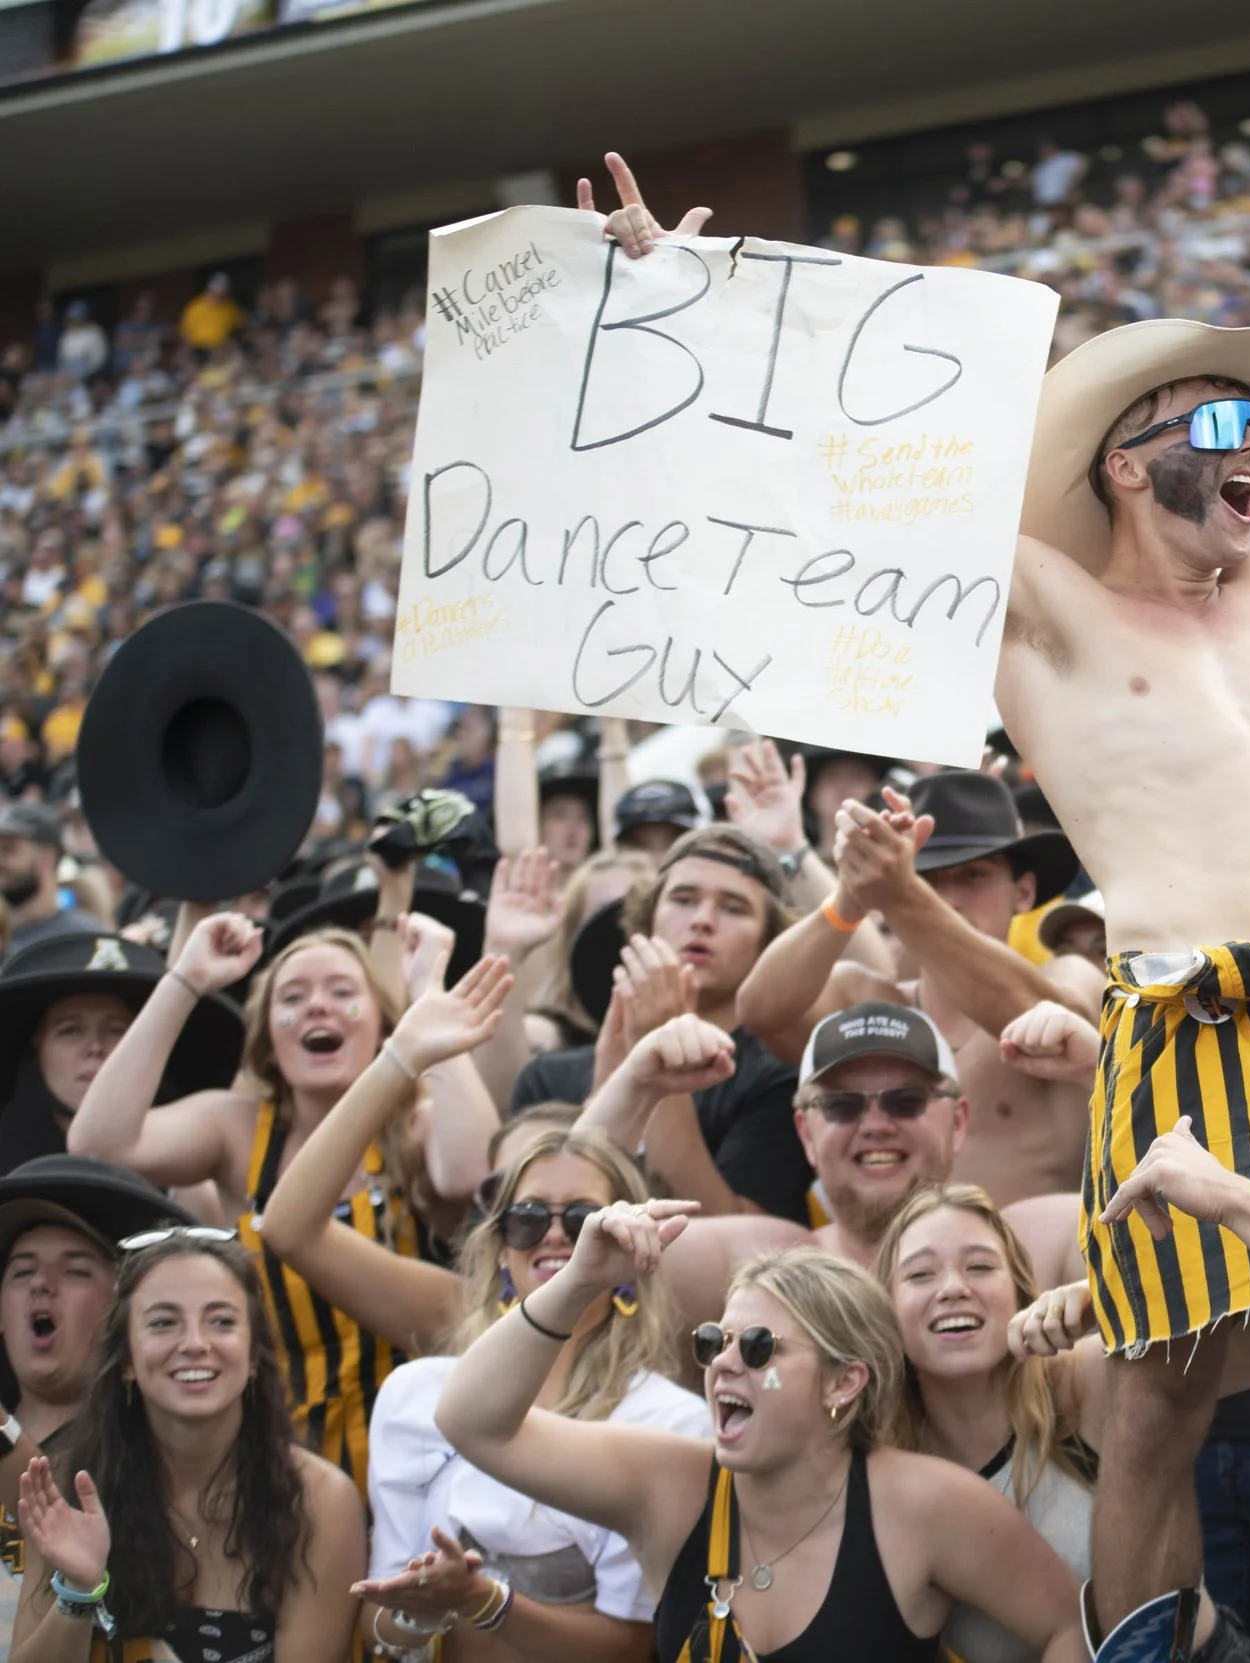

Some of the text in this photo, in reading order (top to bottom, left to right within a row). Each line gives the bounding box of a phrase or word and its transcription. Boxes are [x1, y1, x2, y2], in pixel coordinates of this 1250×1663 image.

[431, 241, 542, 322] #Cancel
[570, 238, 962, 453] BIG
[85, 938, 129, 972] A
